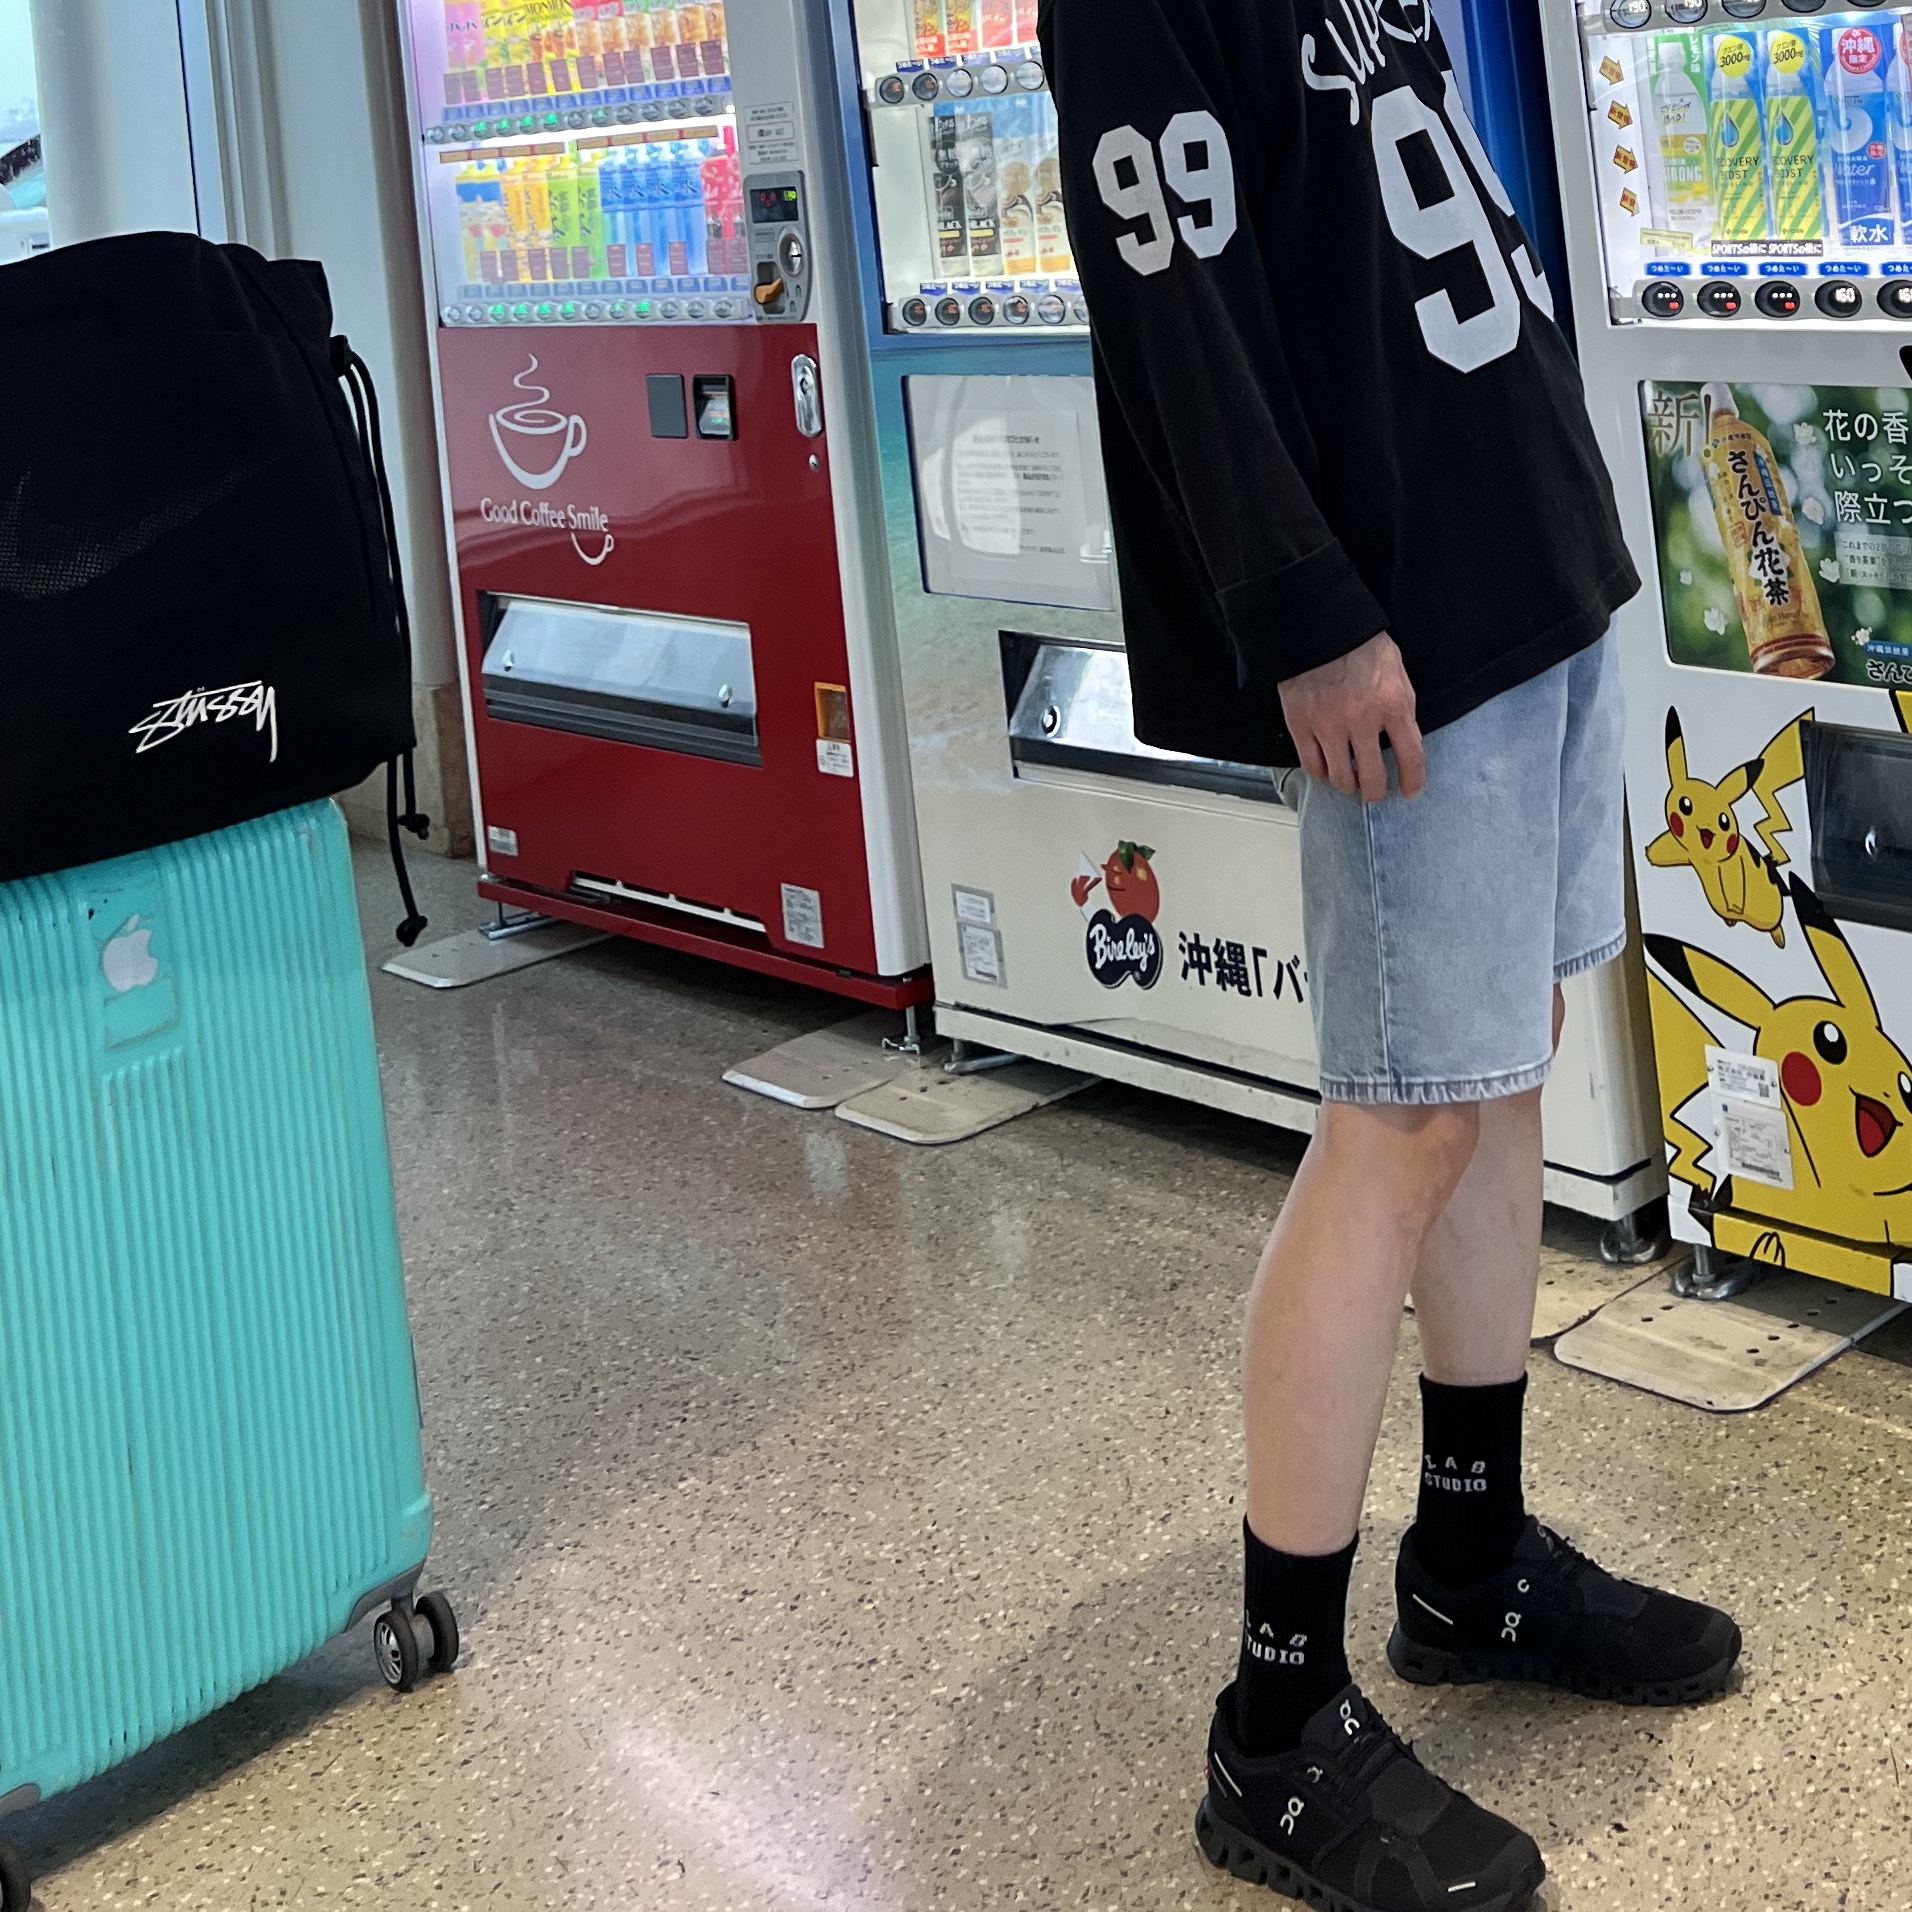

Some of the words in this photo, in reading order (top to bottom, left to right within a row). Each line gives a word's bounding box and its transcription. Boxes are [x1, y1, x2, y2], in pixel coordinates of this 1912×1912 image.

[1092, 110, 1237, 276] 99
[1850, 224, 1888, 244] 軟水
[1822, 409, 1909, 445] 花の香
[1830, 453, 1912, 485] いっそ
[480, 497, 518, 524] Good
[519, 499, 566, 528] Coffee
[567, 503, 609, 532] Smile
[1727, 449, 1790, 606] さんぴん花茶
[1178, 930, 1308, 1003] 沖縄「バ
[1424, 1472, 1488, 1492] STUDIO
[1246, 1633, 1305, 1665] TUDIO
